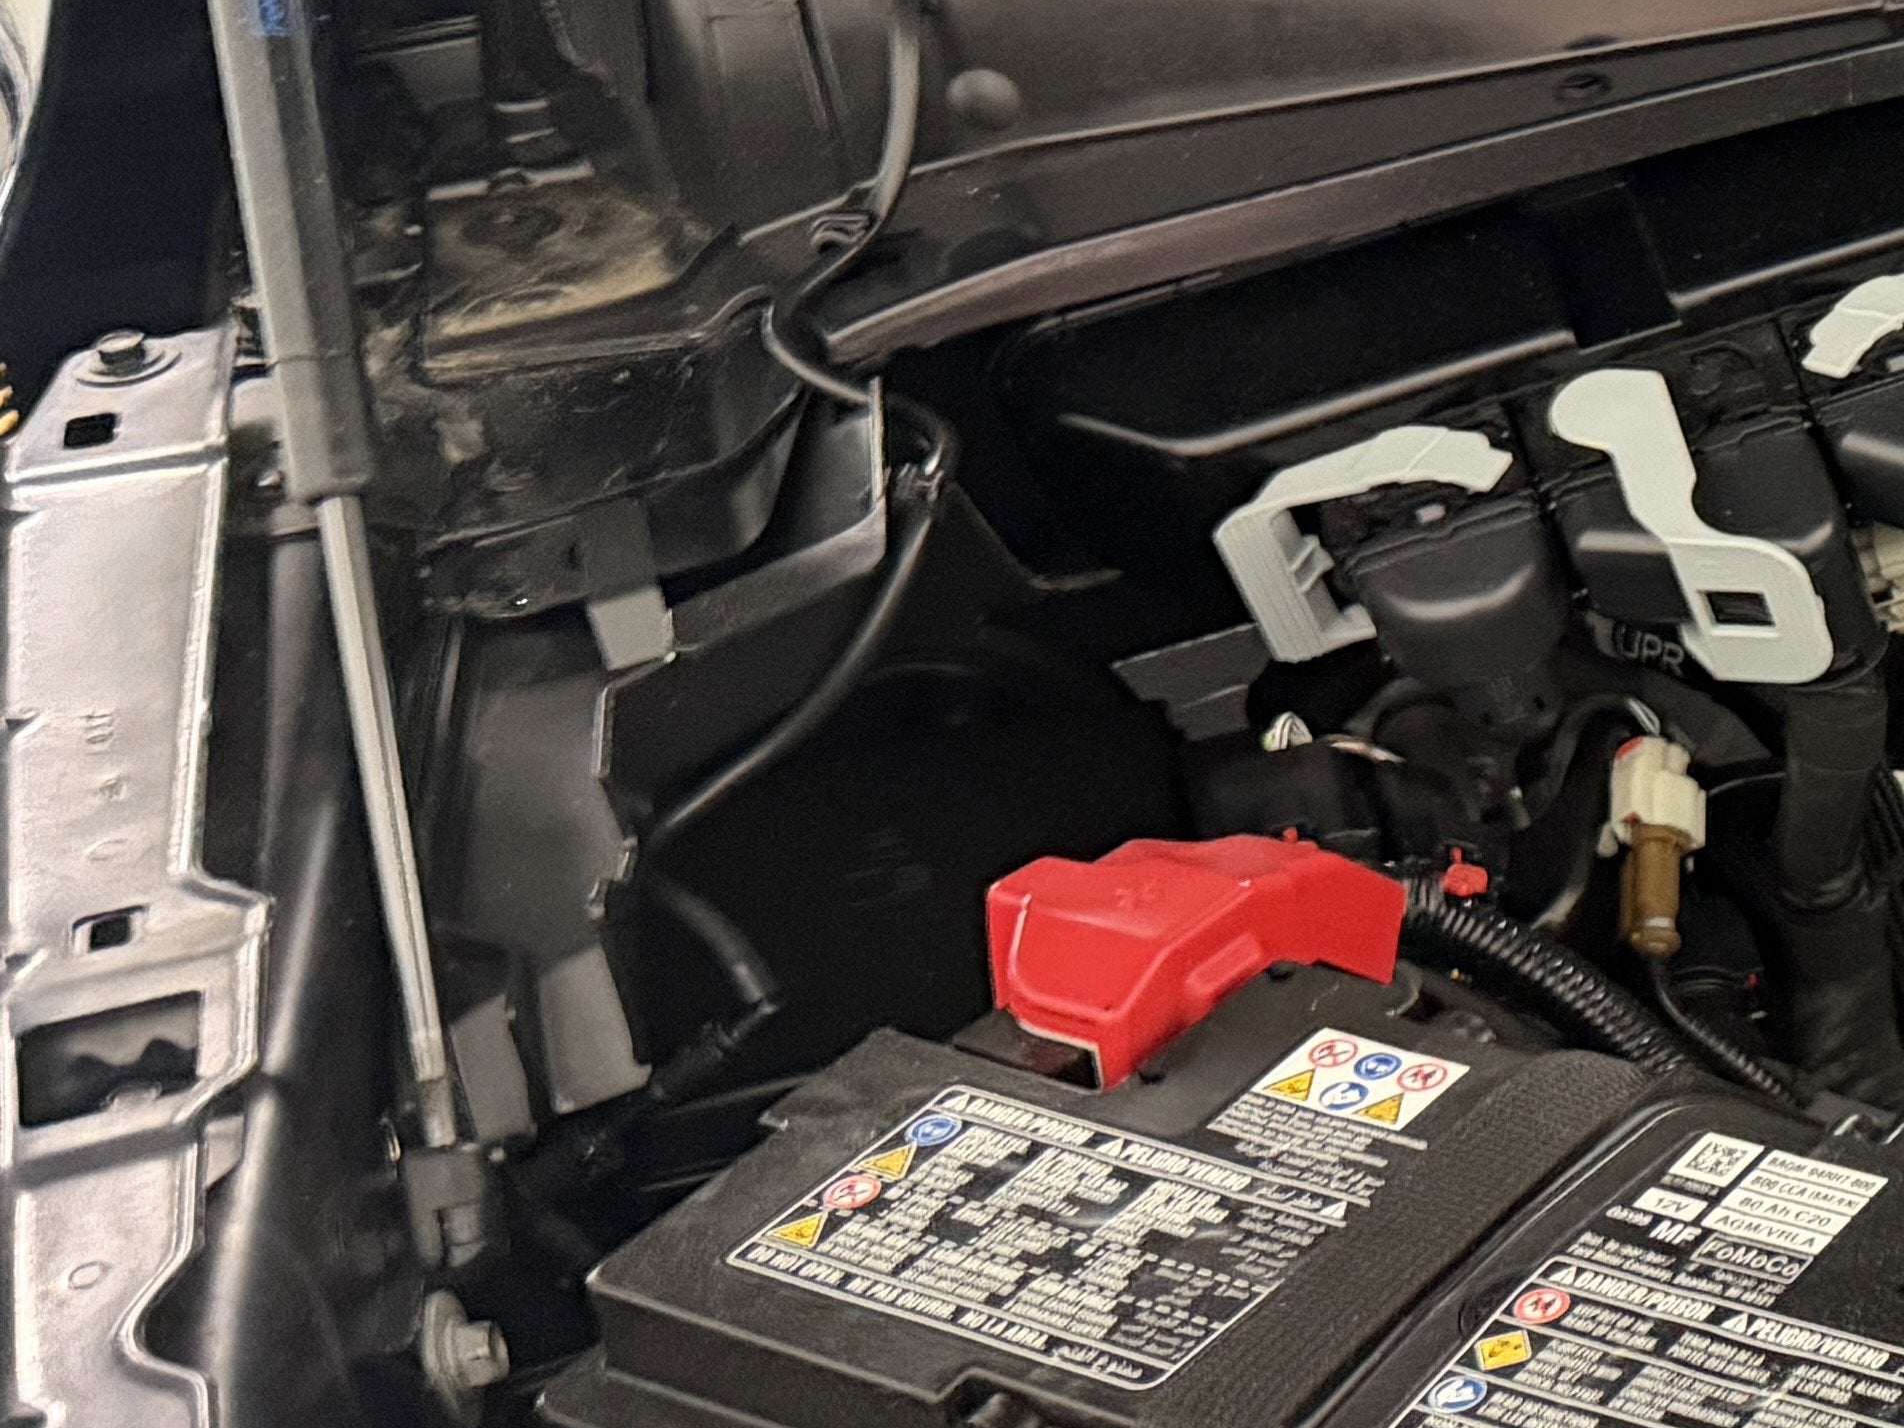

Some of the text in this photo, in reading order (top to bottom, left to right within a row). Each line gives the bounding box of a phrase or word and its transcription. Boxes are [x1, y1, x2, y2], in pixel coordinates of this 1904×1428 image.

[964, 1095, 1096, 1147] DANGER/POISON
[1116, 1140, 1251, 1195] PELIGRO/VENENO
[1649, 1196, 1691, 1214] 12V
[1791, 1209, 1833, 1228] C20
[1643, 1218, 1705, 1248] MF
[1698, 1237, 1805, 1278] FoMoCo
[1571, 1270, 1717, 1322] DANGER/POISON
[1744, 1316, 1892, 1370] PELIGRO/VENENO
